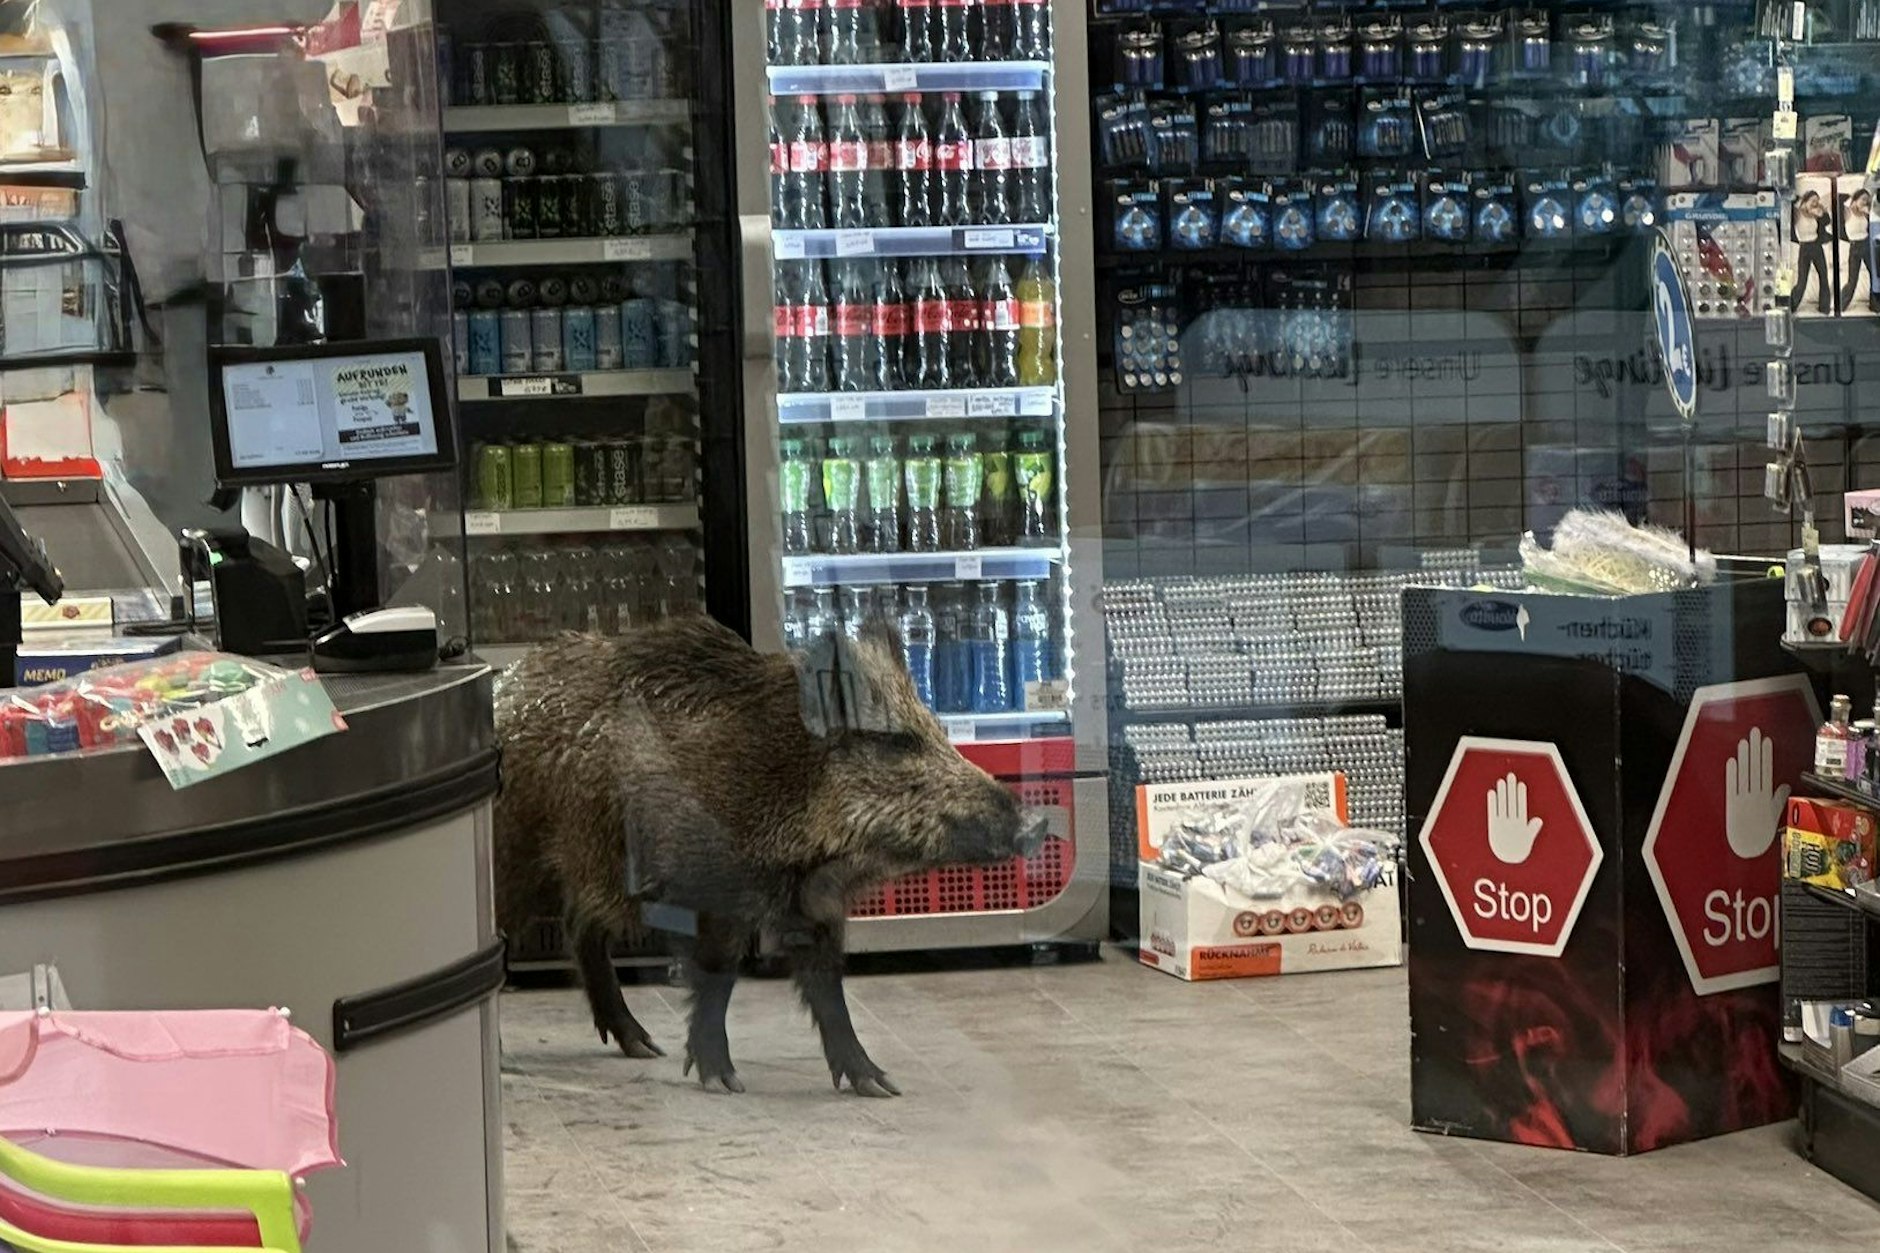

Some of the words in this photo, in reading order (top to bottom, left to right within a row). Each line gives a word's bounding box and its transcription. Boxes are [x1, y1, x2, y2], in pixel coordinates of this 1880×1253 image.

[337, 364, 408, 383] AUFRUNDEN
[24, 667, 67, 683] MEMO
[1153, 793, 1177, 803] JEDE
[1180, 790, 1228, 801] BATTERIE
[1231, 786, 1258, 798] ZÄH
[1473, 879, 1553, 932] Stop
